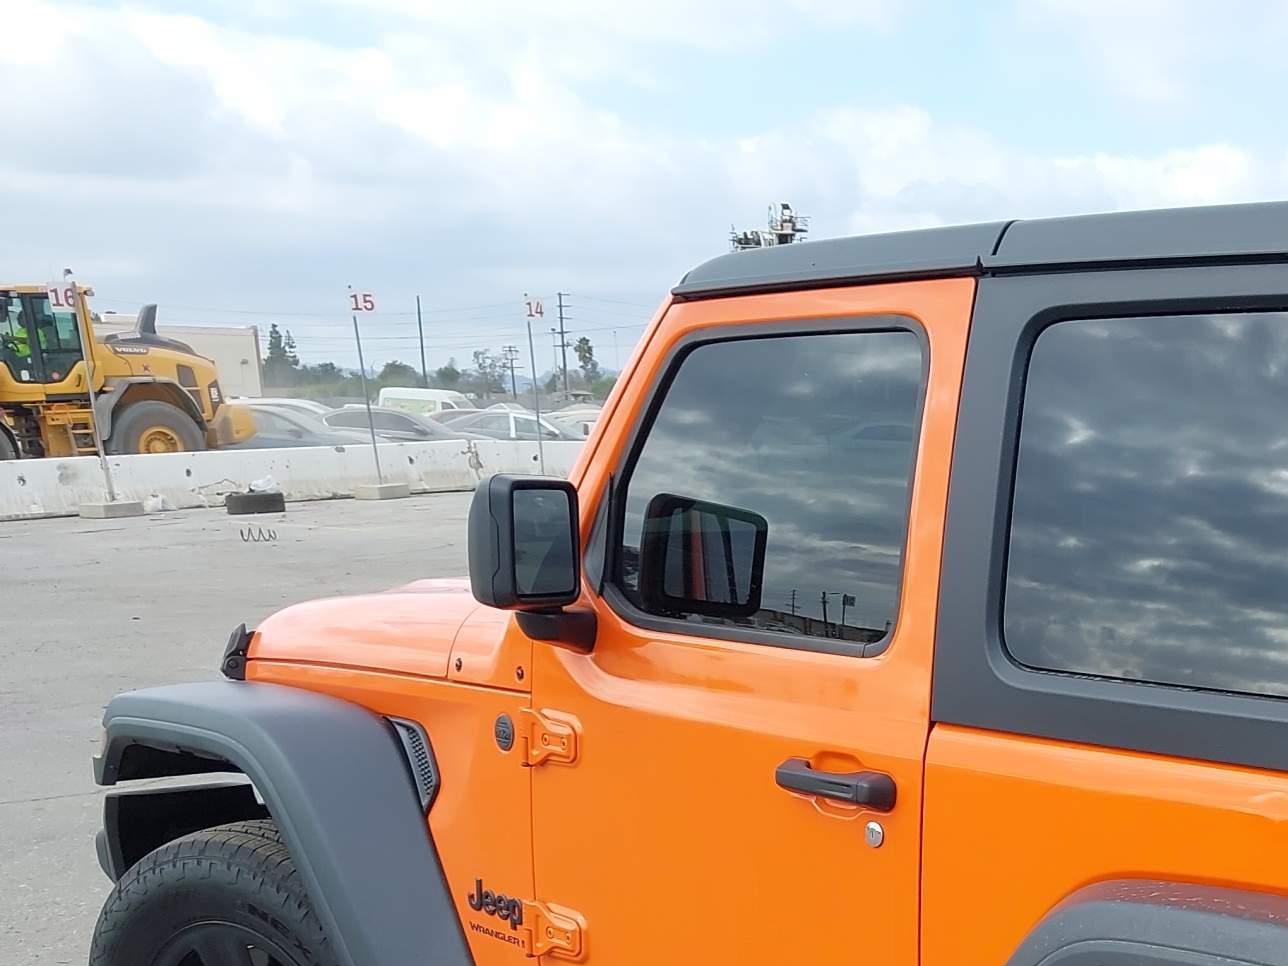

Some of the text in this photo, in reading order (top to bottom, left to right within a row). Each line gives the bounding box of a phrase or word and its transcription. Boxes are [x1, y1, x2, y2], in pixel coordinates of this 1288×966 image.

[49, 288, 75, 307] 16
[350, 293, 375, 312] 15
[525, 300, 544, 318] 14
[467, 878, 523, 931] Jeep
[469, 920, 521, 948] WRANGLER
